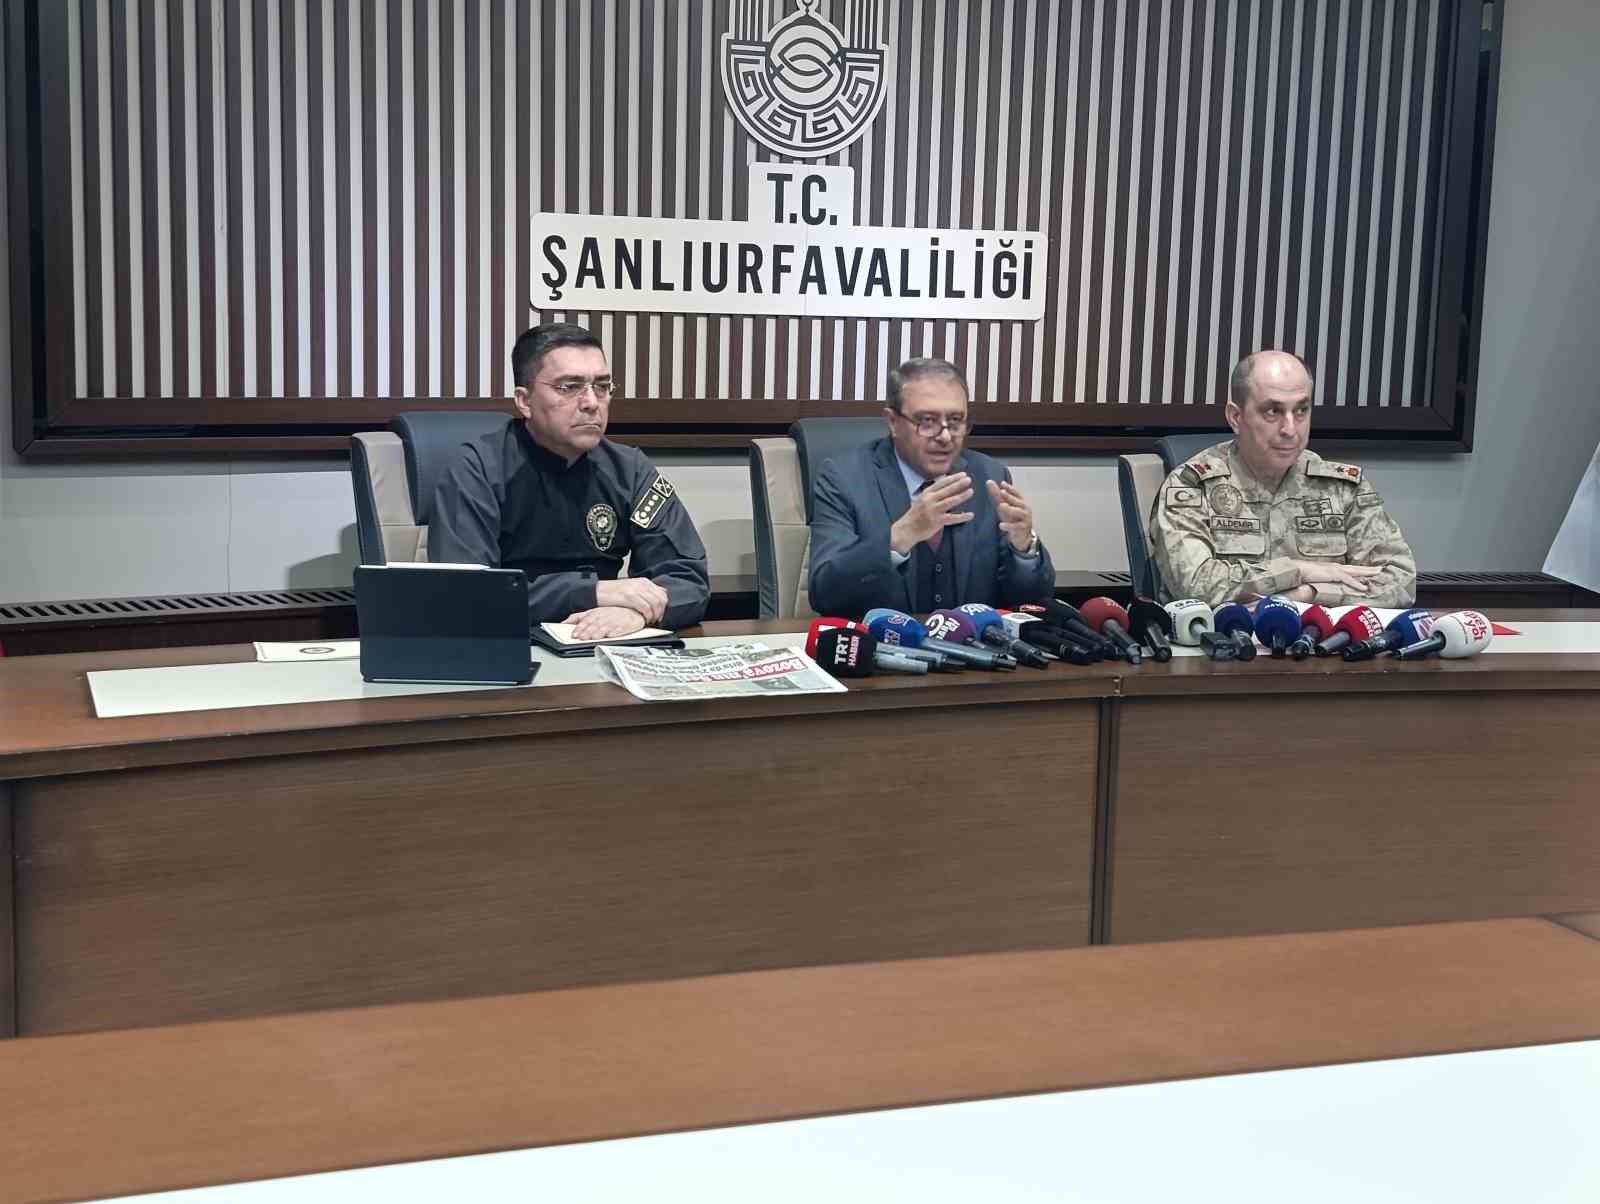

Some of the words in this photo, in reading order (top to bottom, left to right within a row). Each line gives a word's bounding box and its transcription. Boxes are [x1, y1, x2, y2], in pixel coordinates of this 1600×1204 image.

[766, 173, 838, 226] T.C.
[834, 634, 849, 664] TRT
[848, 635, 860, 667] HABER
